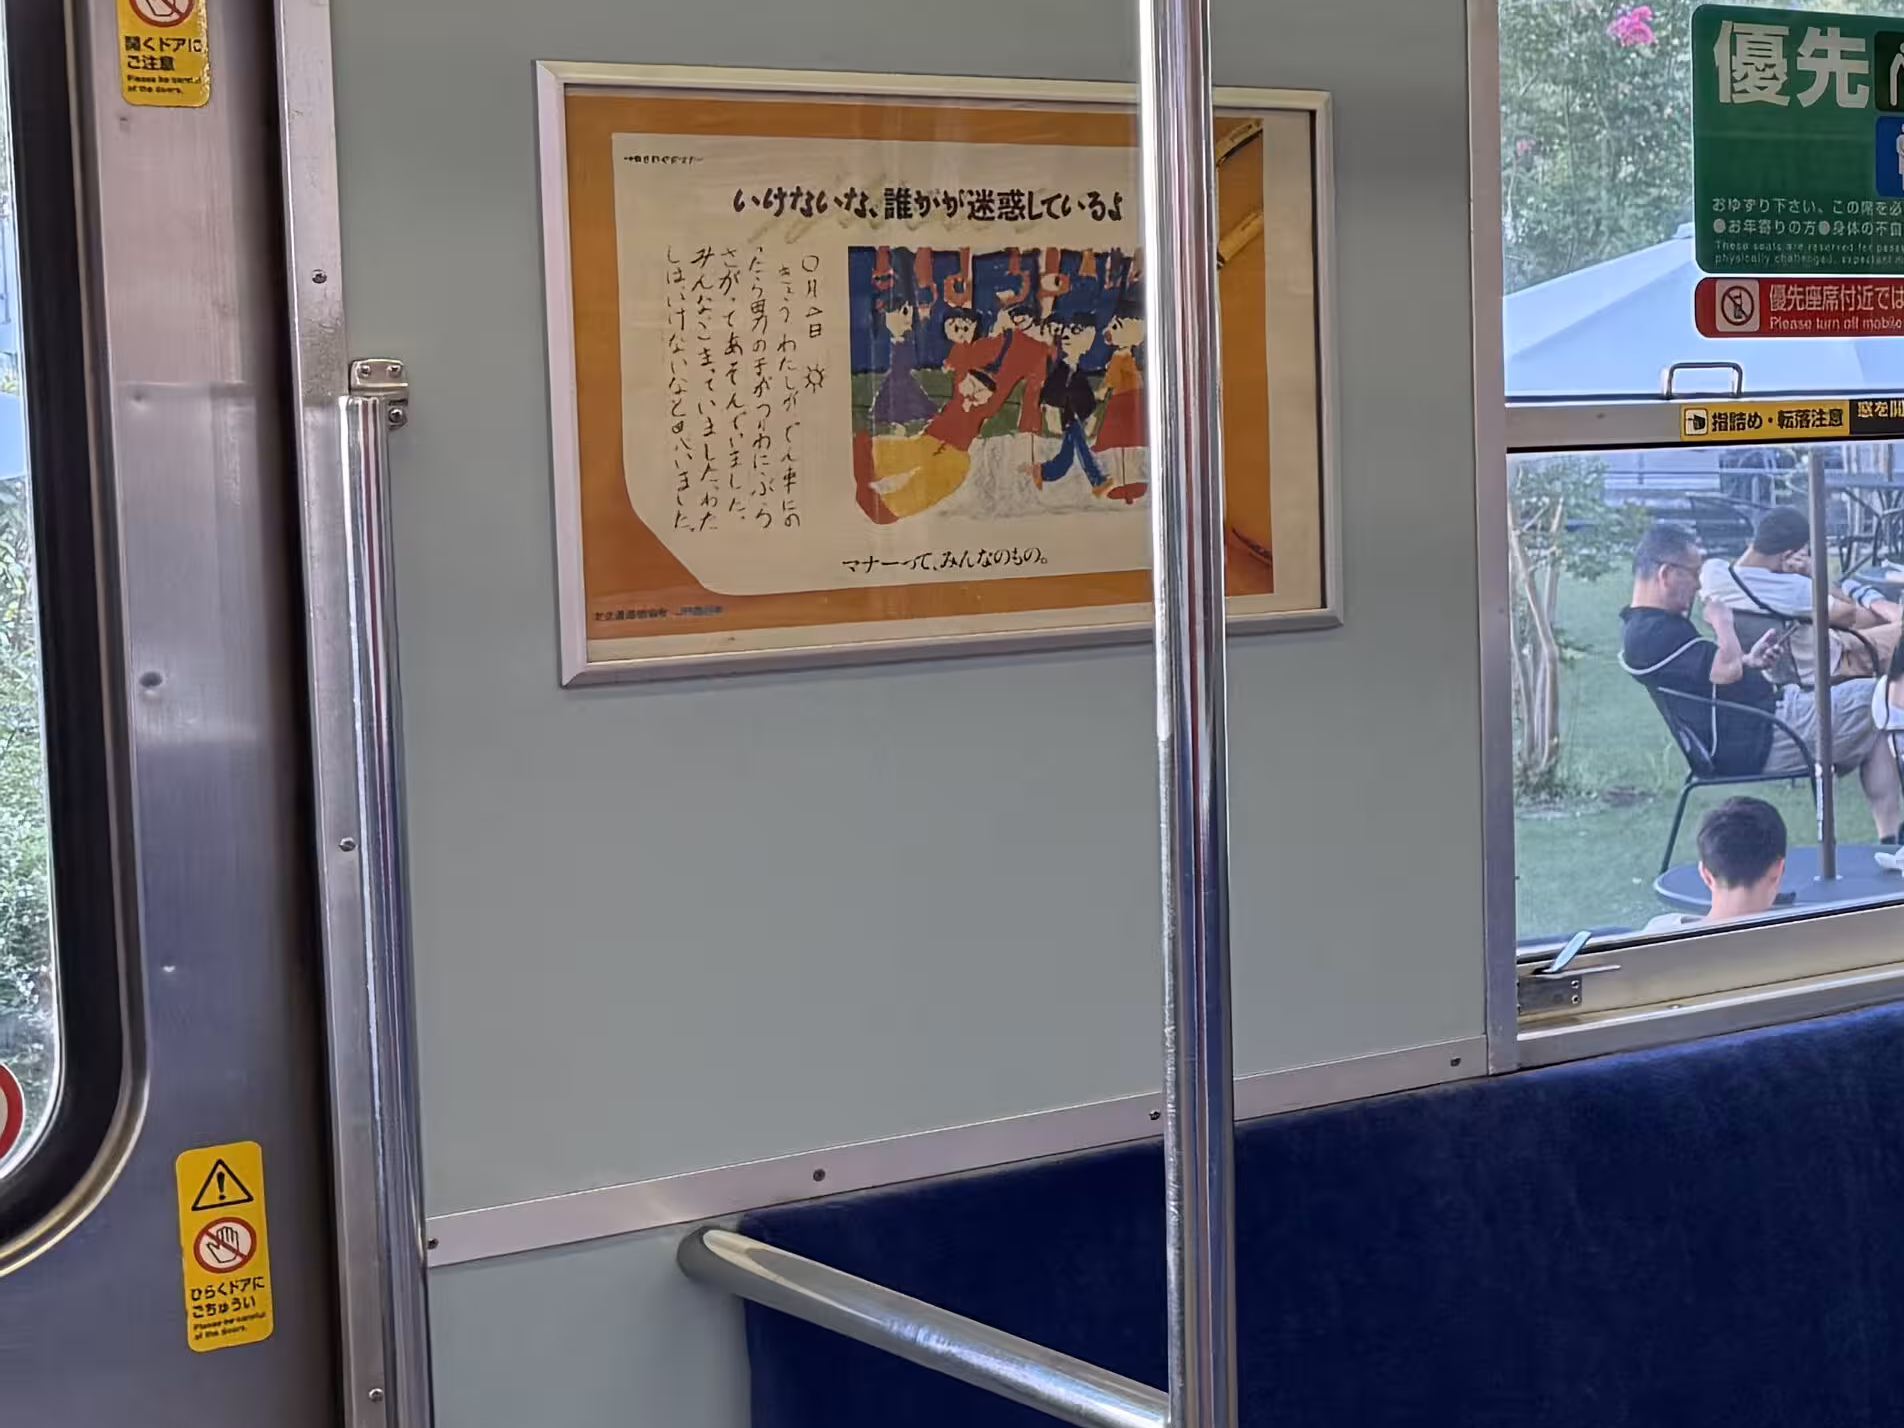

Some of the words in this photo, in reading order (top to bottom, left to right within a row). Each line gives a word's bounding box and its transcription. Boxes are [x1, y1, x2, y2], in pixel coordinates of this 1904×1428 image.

[1713, 20, 1869, 108] 優先
[1770, 316, 1812, 330] Please
[842, 547, 1047, 573] マナーって、みんなのもの。
[191, 1276, 264, 1301] ひらくドアに
[193, 1295, 255, 1318] ごちゅうい
